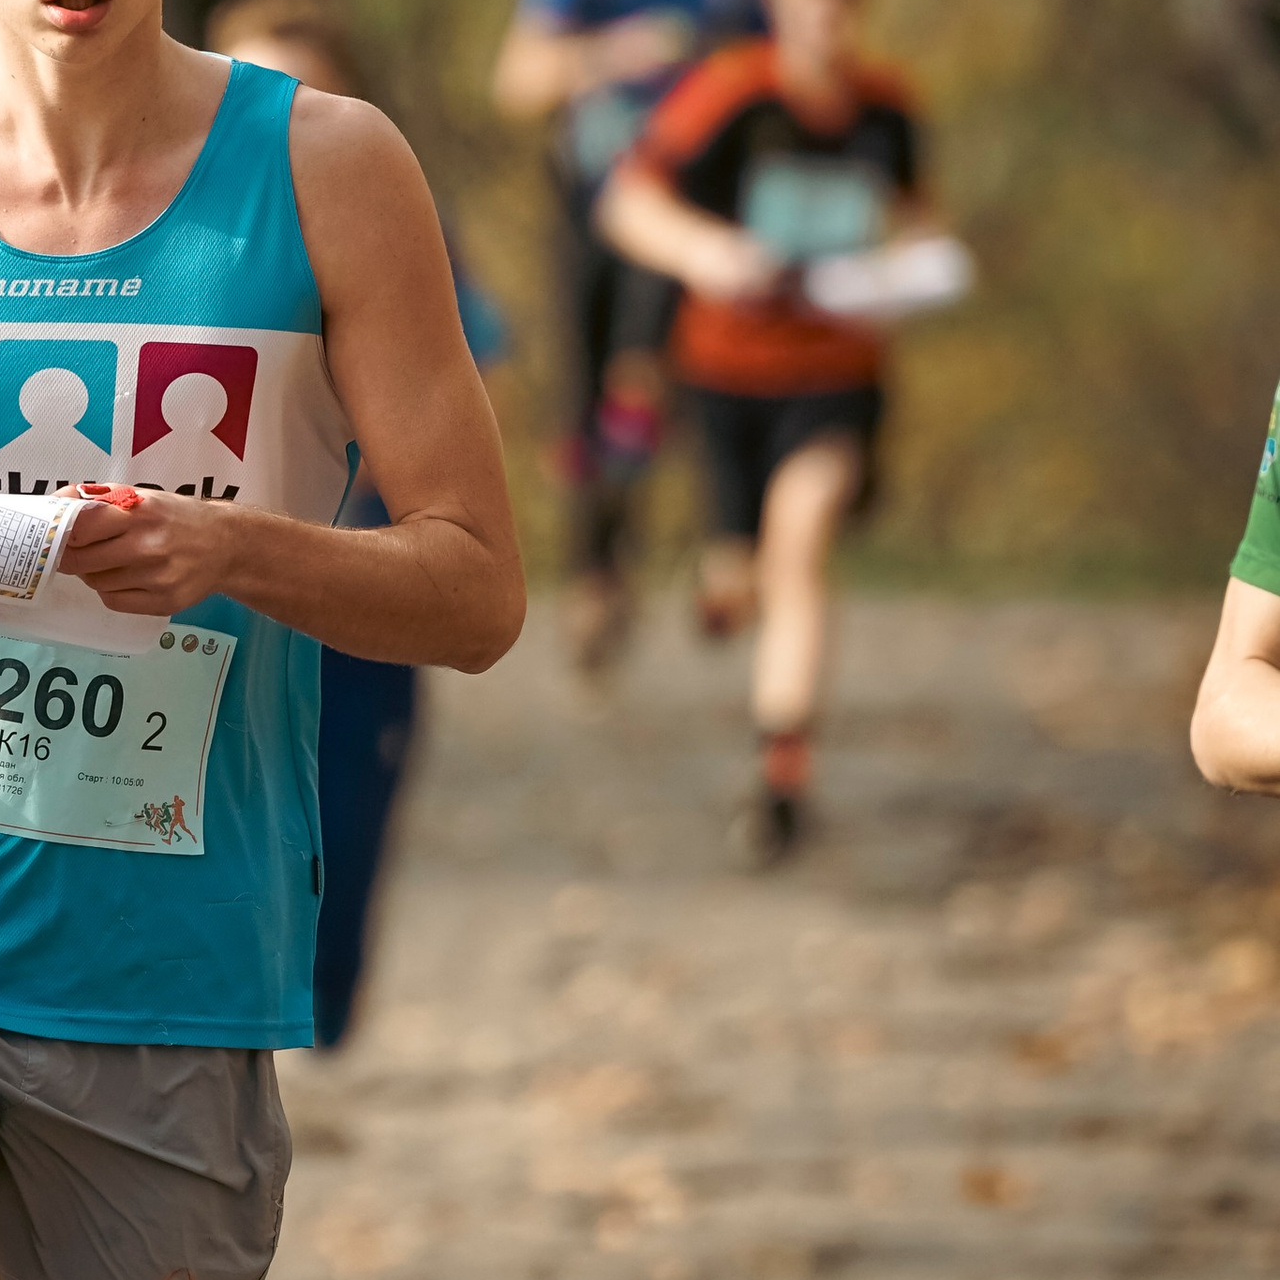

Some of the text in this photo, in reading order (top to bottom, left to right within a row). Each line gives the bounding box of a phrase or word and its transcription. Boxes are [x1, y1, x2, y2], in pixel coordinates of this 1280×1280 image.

[140, 711, 168, 752] 2
[6, 772, 27, 784] обл.
[77, 772, 104, 784] Старт
[111, 776, 145, 787] 10:05:00
